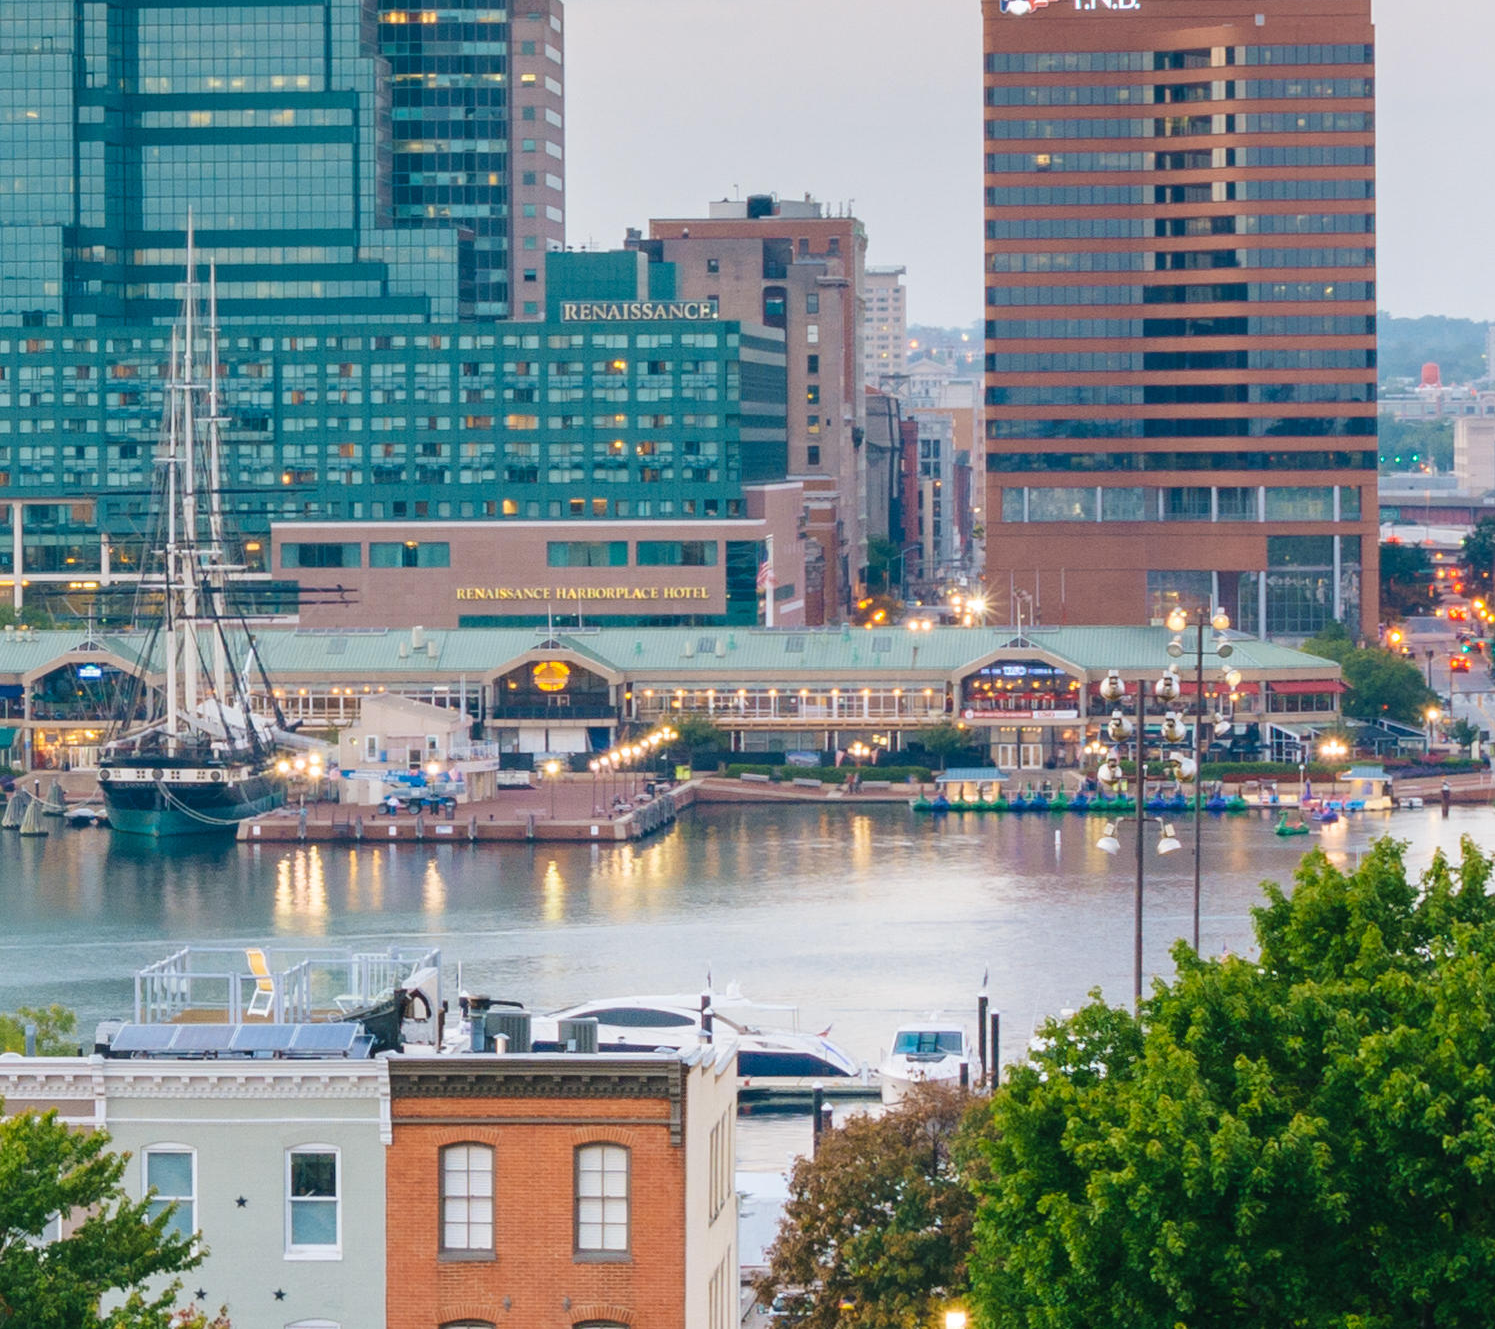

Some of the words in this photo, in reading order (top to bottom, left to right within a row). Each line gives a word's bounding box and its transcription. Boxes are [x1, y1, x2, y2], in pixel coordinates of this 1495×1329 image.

[456, 587, 550, 600] RENAISSANCE
[556, 587, 658, 600] HARBORPLACE
[663, 587, 710, 600] HOTEL
